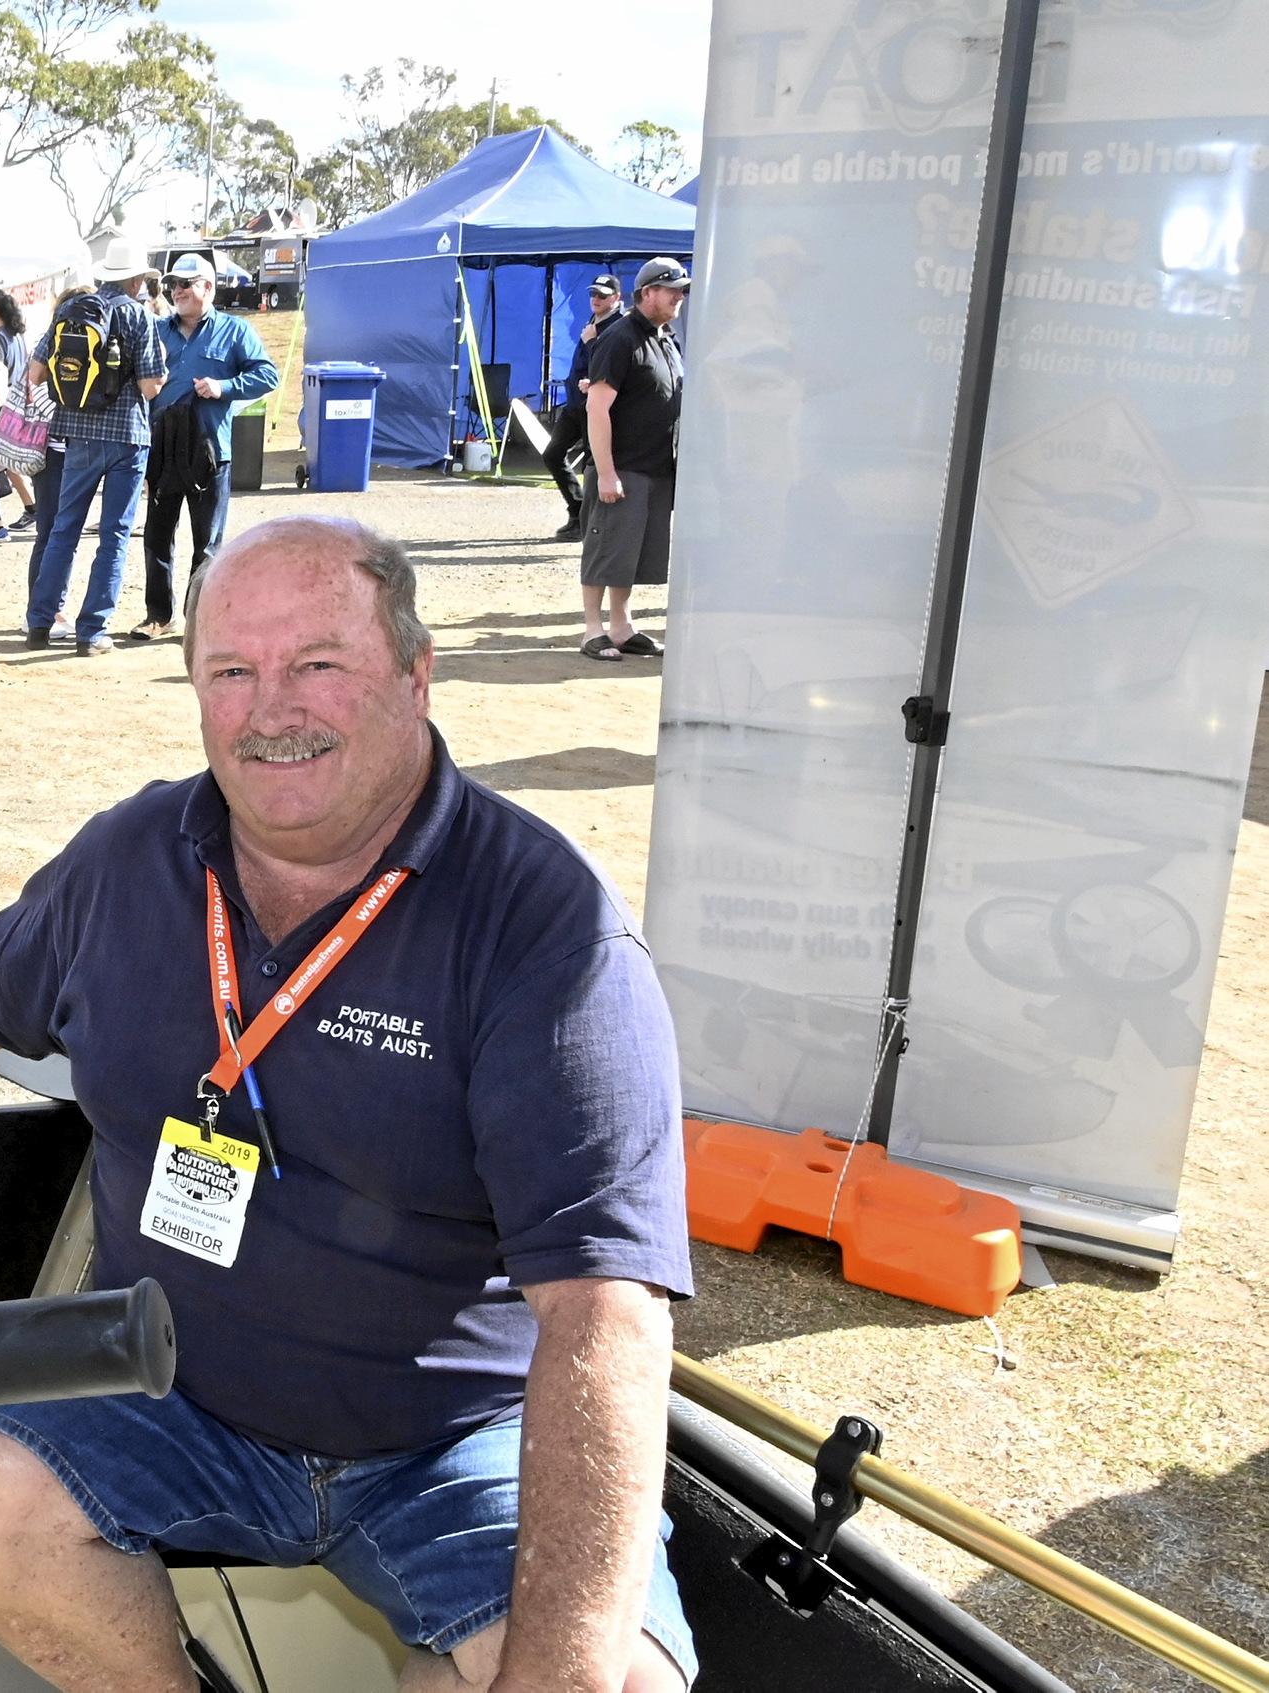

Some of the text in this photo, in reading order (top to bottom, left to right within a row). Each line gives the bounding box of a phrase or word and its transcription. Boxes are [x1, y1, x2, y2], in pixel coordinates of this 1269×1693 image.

[338, 1005, 424, 1036] PORTABLE
[317, 1019, 433, 1060] BOATS AUST.
[177, 1152, 230, 1178] OUTDOOR
[221, 1142, 250, 1160] 2019
[170, 1160, 235, 1191] ADVENTURE
[156, 1191, 180, 1205] Portable
[181, 1201, 199, 1213] Boats
[201, 1209, 231, 1224] Australia
[152, 1216, 223, 1253] EXHIBITOR
